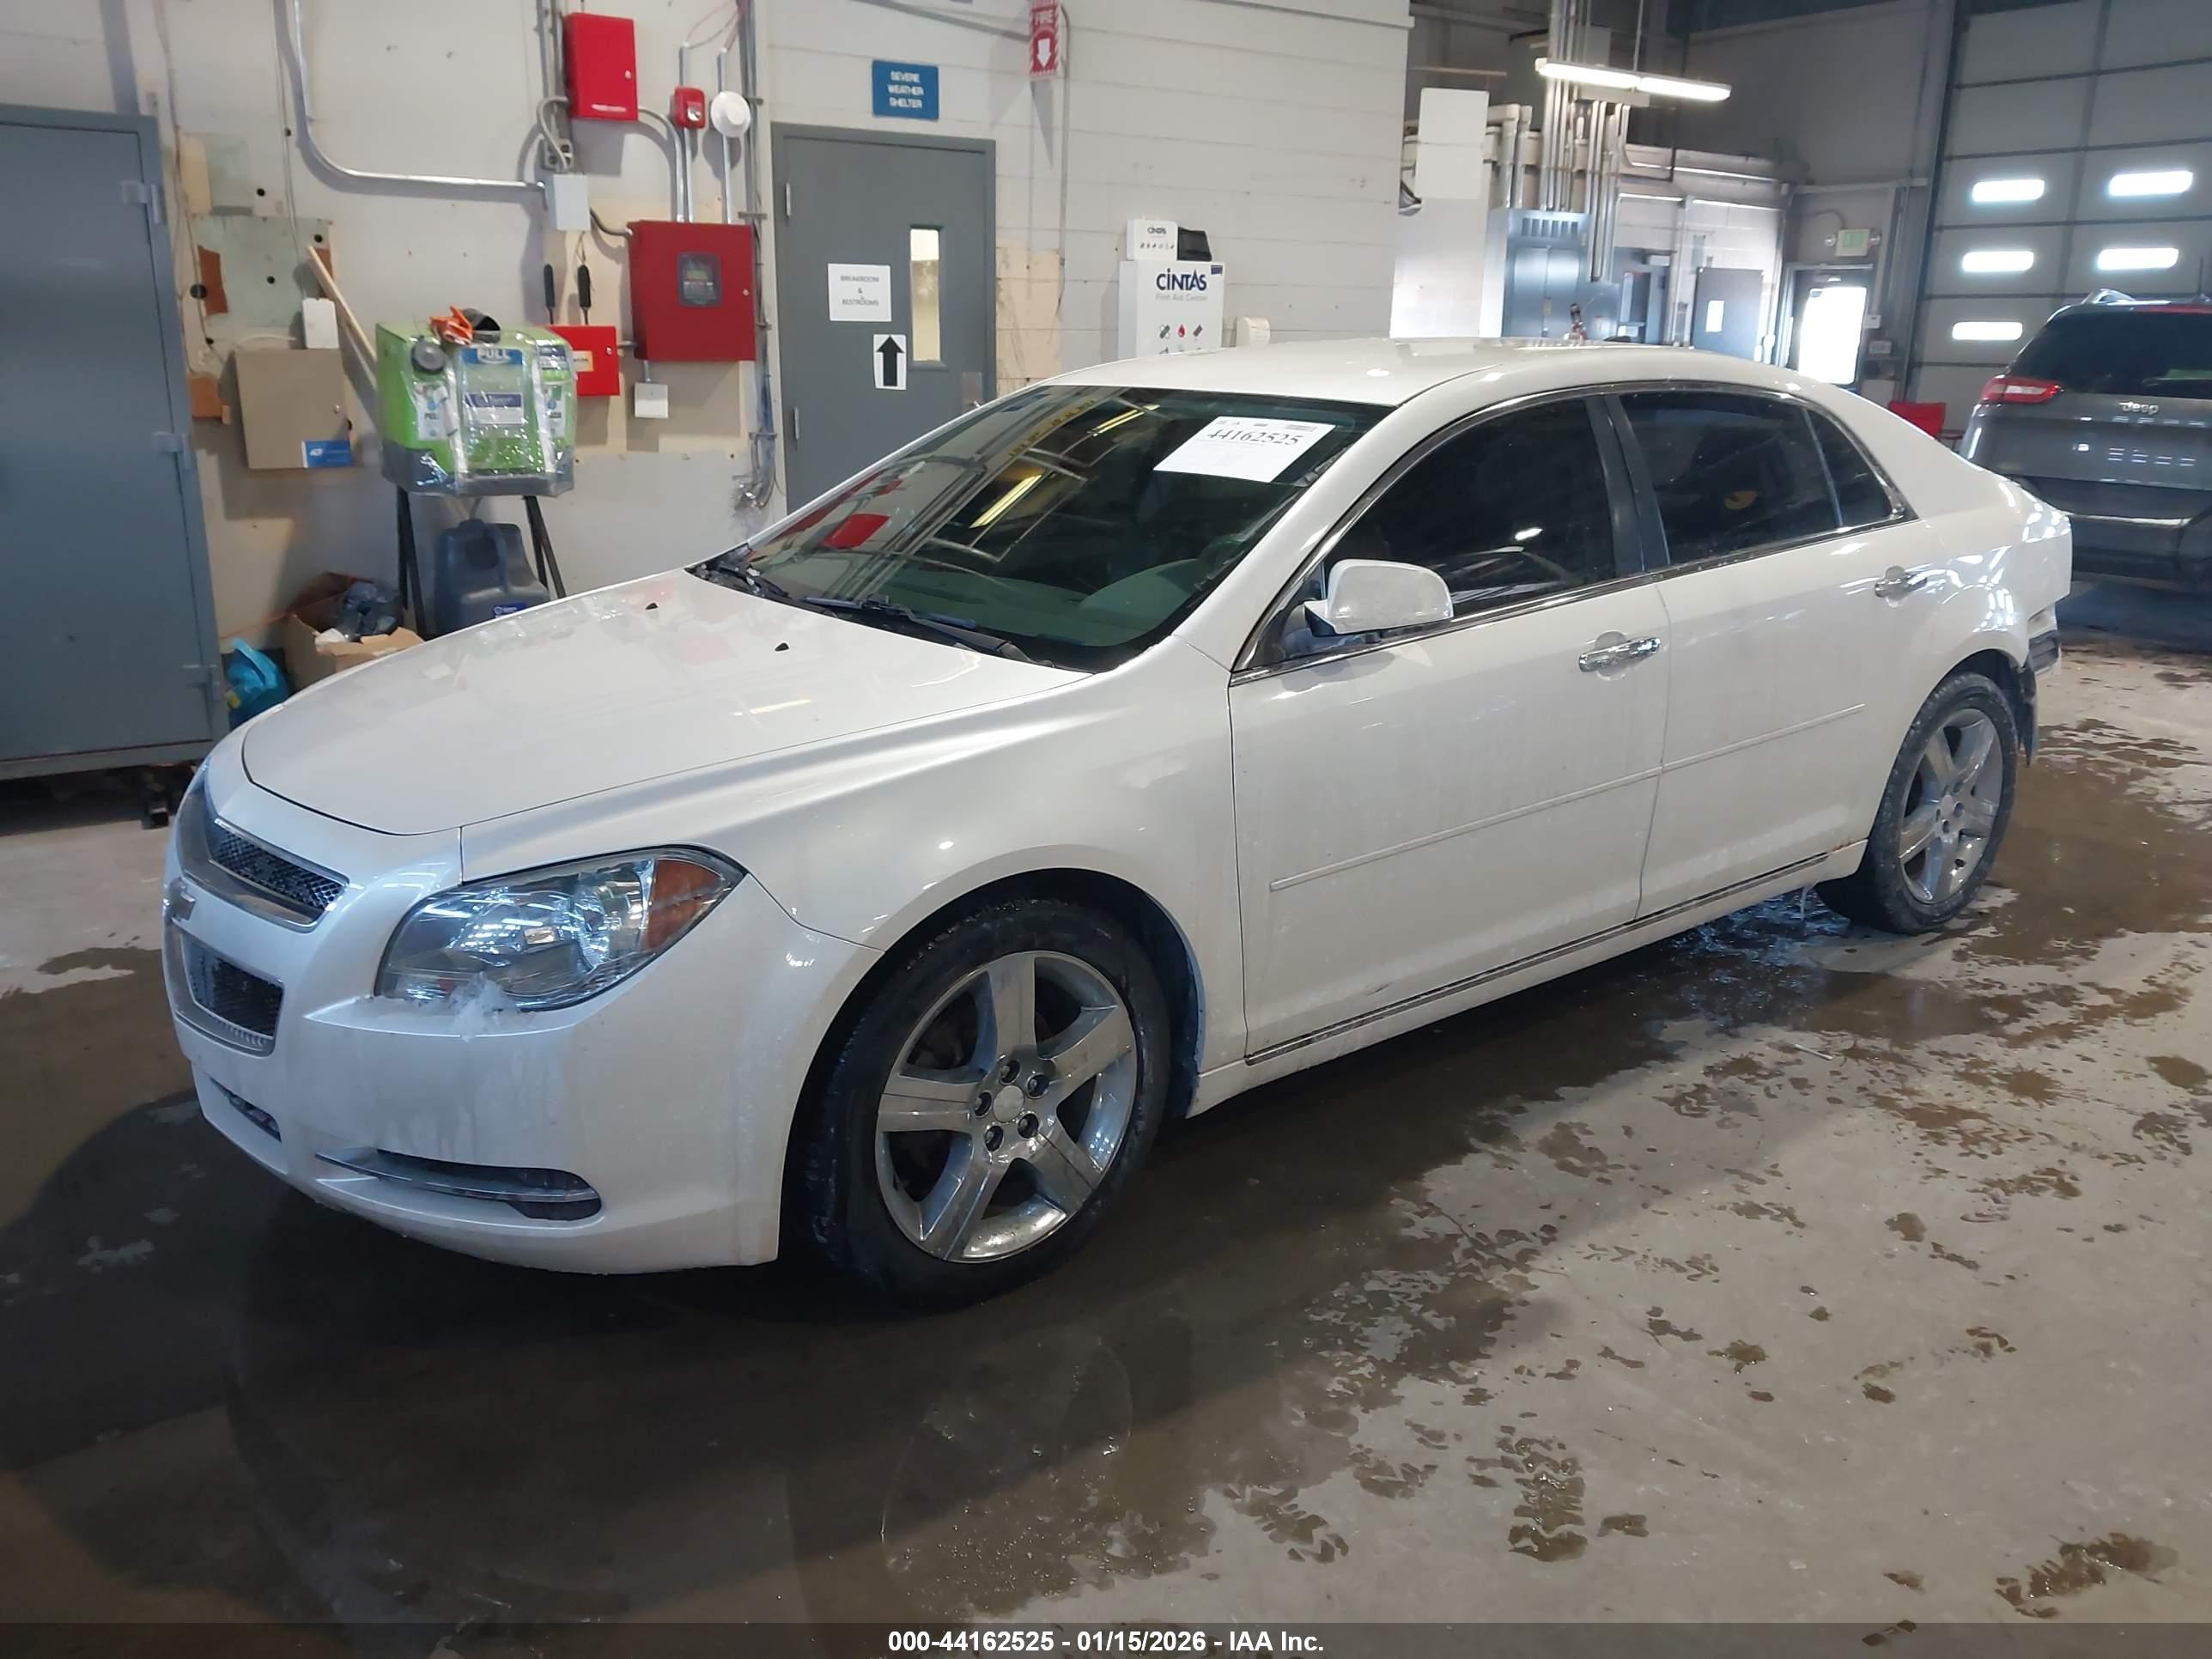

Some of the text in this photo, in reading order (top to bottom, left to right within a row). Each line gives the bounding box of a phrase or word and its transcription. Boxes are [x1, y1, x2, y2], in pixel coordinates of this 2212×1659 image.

[890, 70, 920, 83] SEVERE
[887, 83, 924, 95] WEATHER
[889, 97, 922, 108] SHELTER
[2118, 400, 2159, 415] Jeep
[1207, 429, 1305, 446] 44162525
